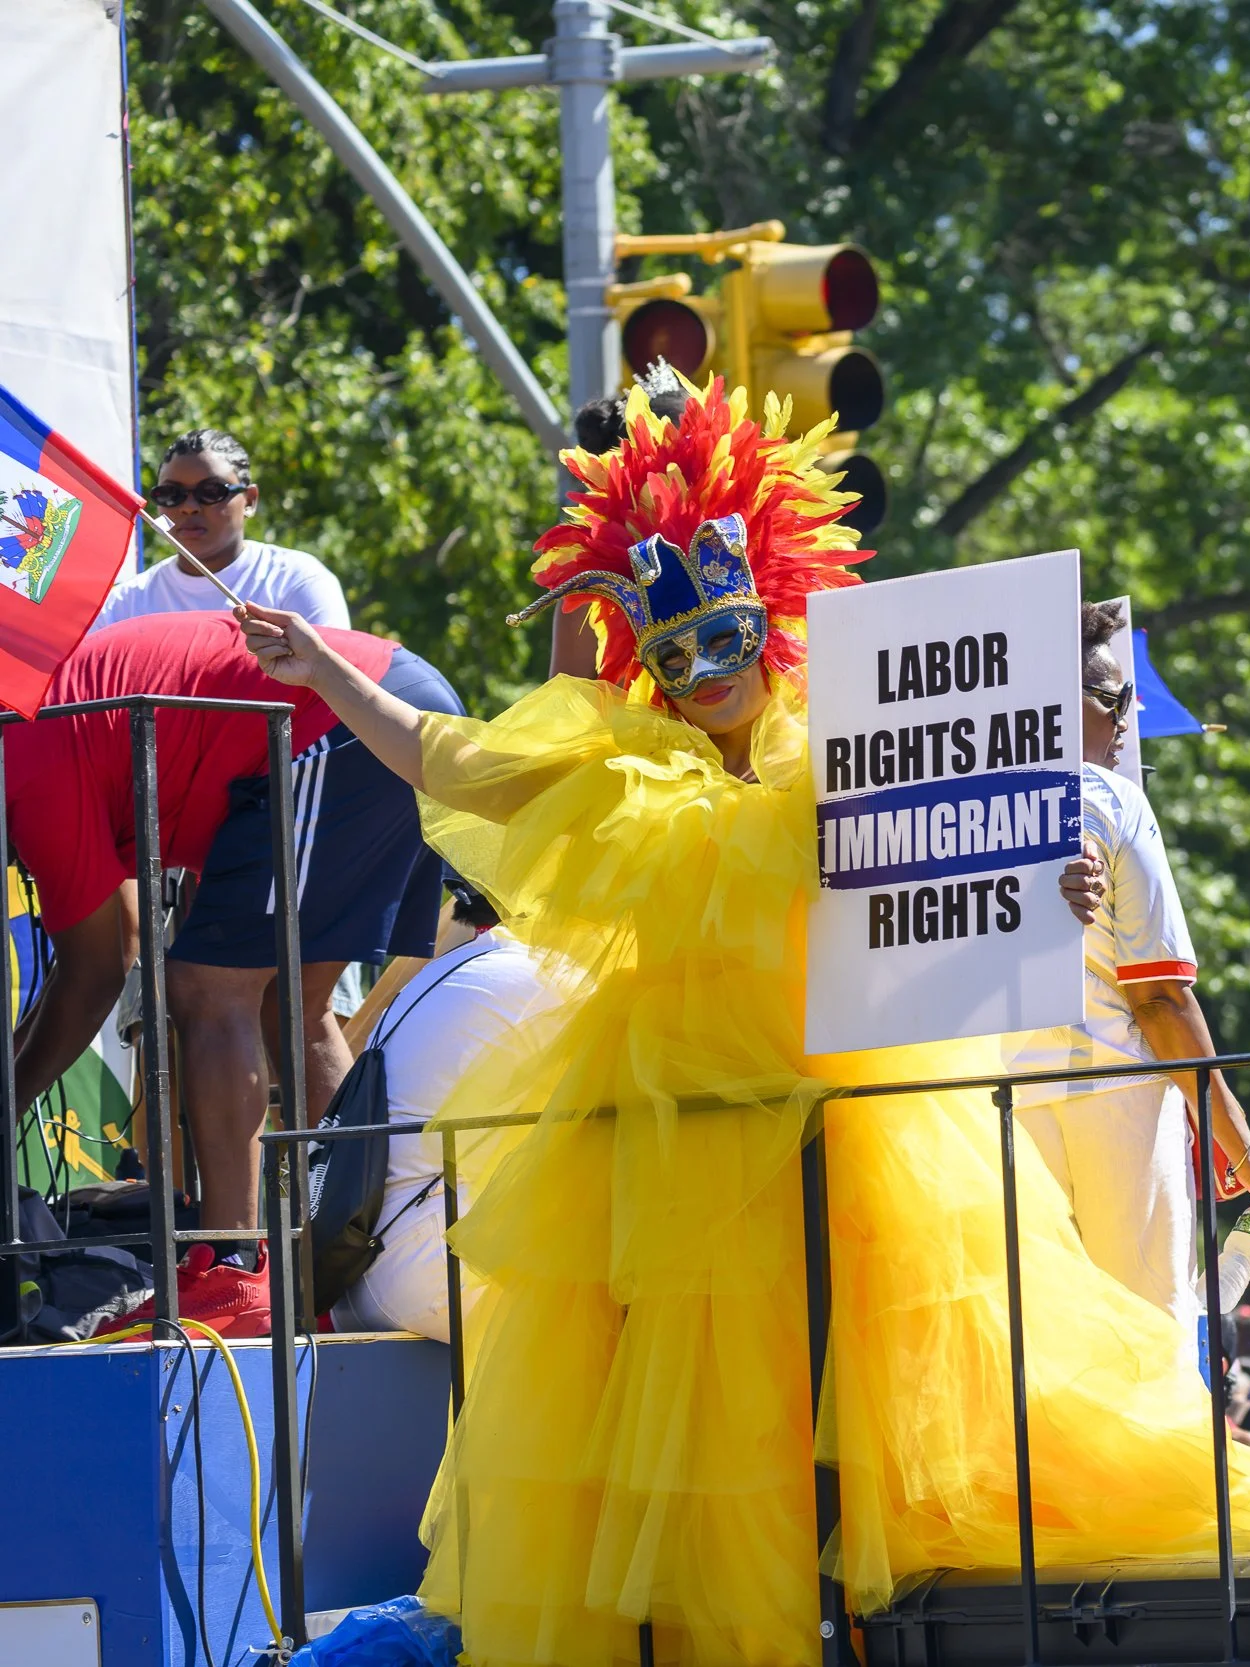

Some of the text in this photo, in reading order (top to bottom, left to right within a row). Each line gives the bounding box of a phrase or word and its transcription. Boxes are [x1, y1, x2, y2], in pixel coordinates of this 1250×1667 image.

[877, 631, 1009, 704] LABOR
[826, 704, 1064, 793] RIGHTS ARE
[825, 785, 1066, 874] IMMIGRANT
[868, 875, 1021, 949] RIGHTS
